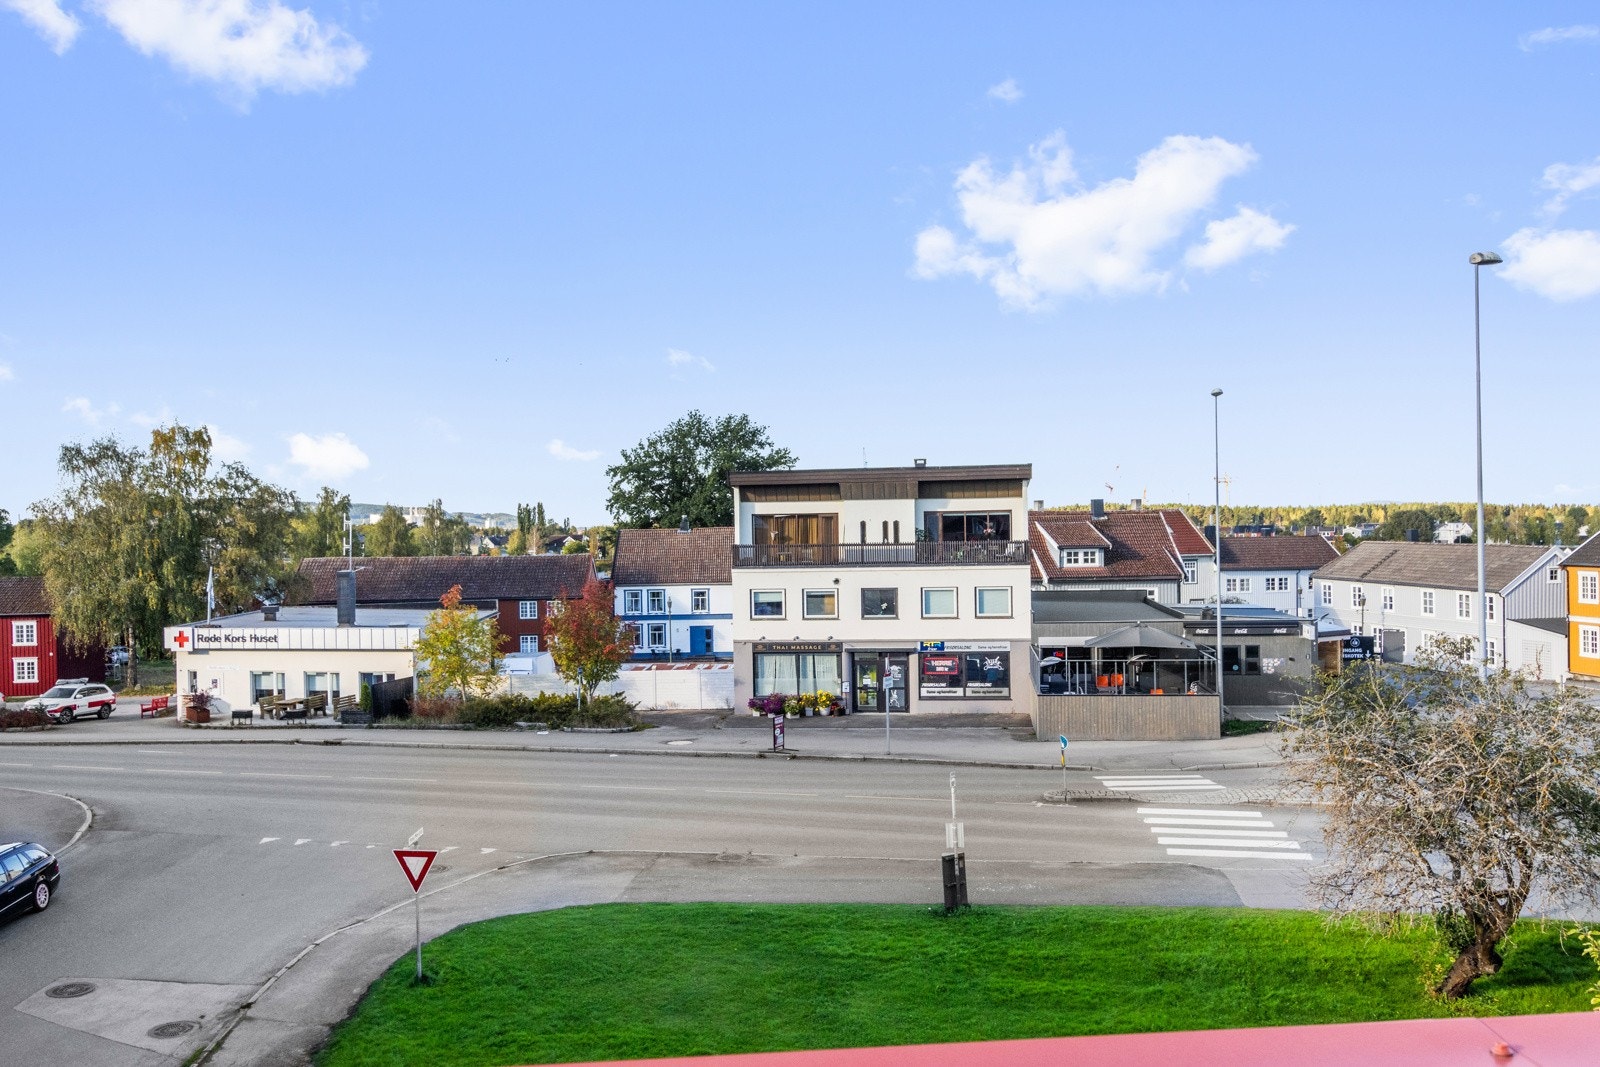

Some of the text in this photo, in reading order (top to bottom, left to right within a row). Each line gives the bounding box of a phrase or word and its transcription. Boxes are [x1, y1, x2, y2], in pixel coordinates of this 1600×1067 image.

[197, 634, 278, 643] Røde Kors Huset
